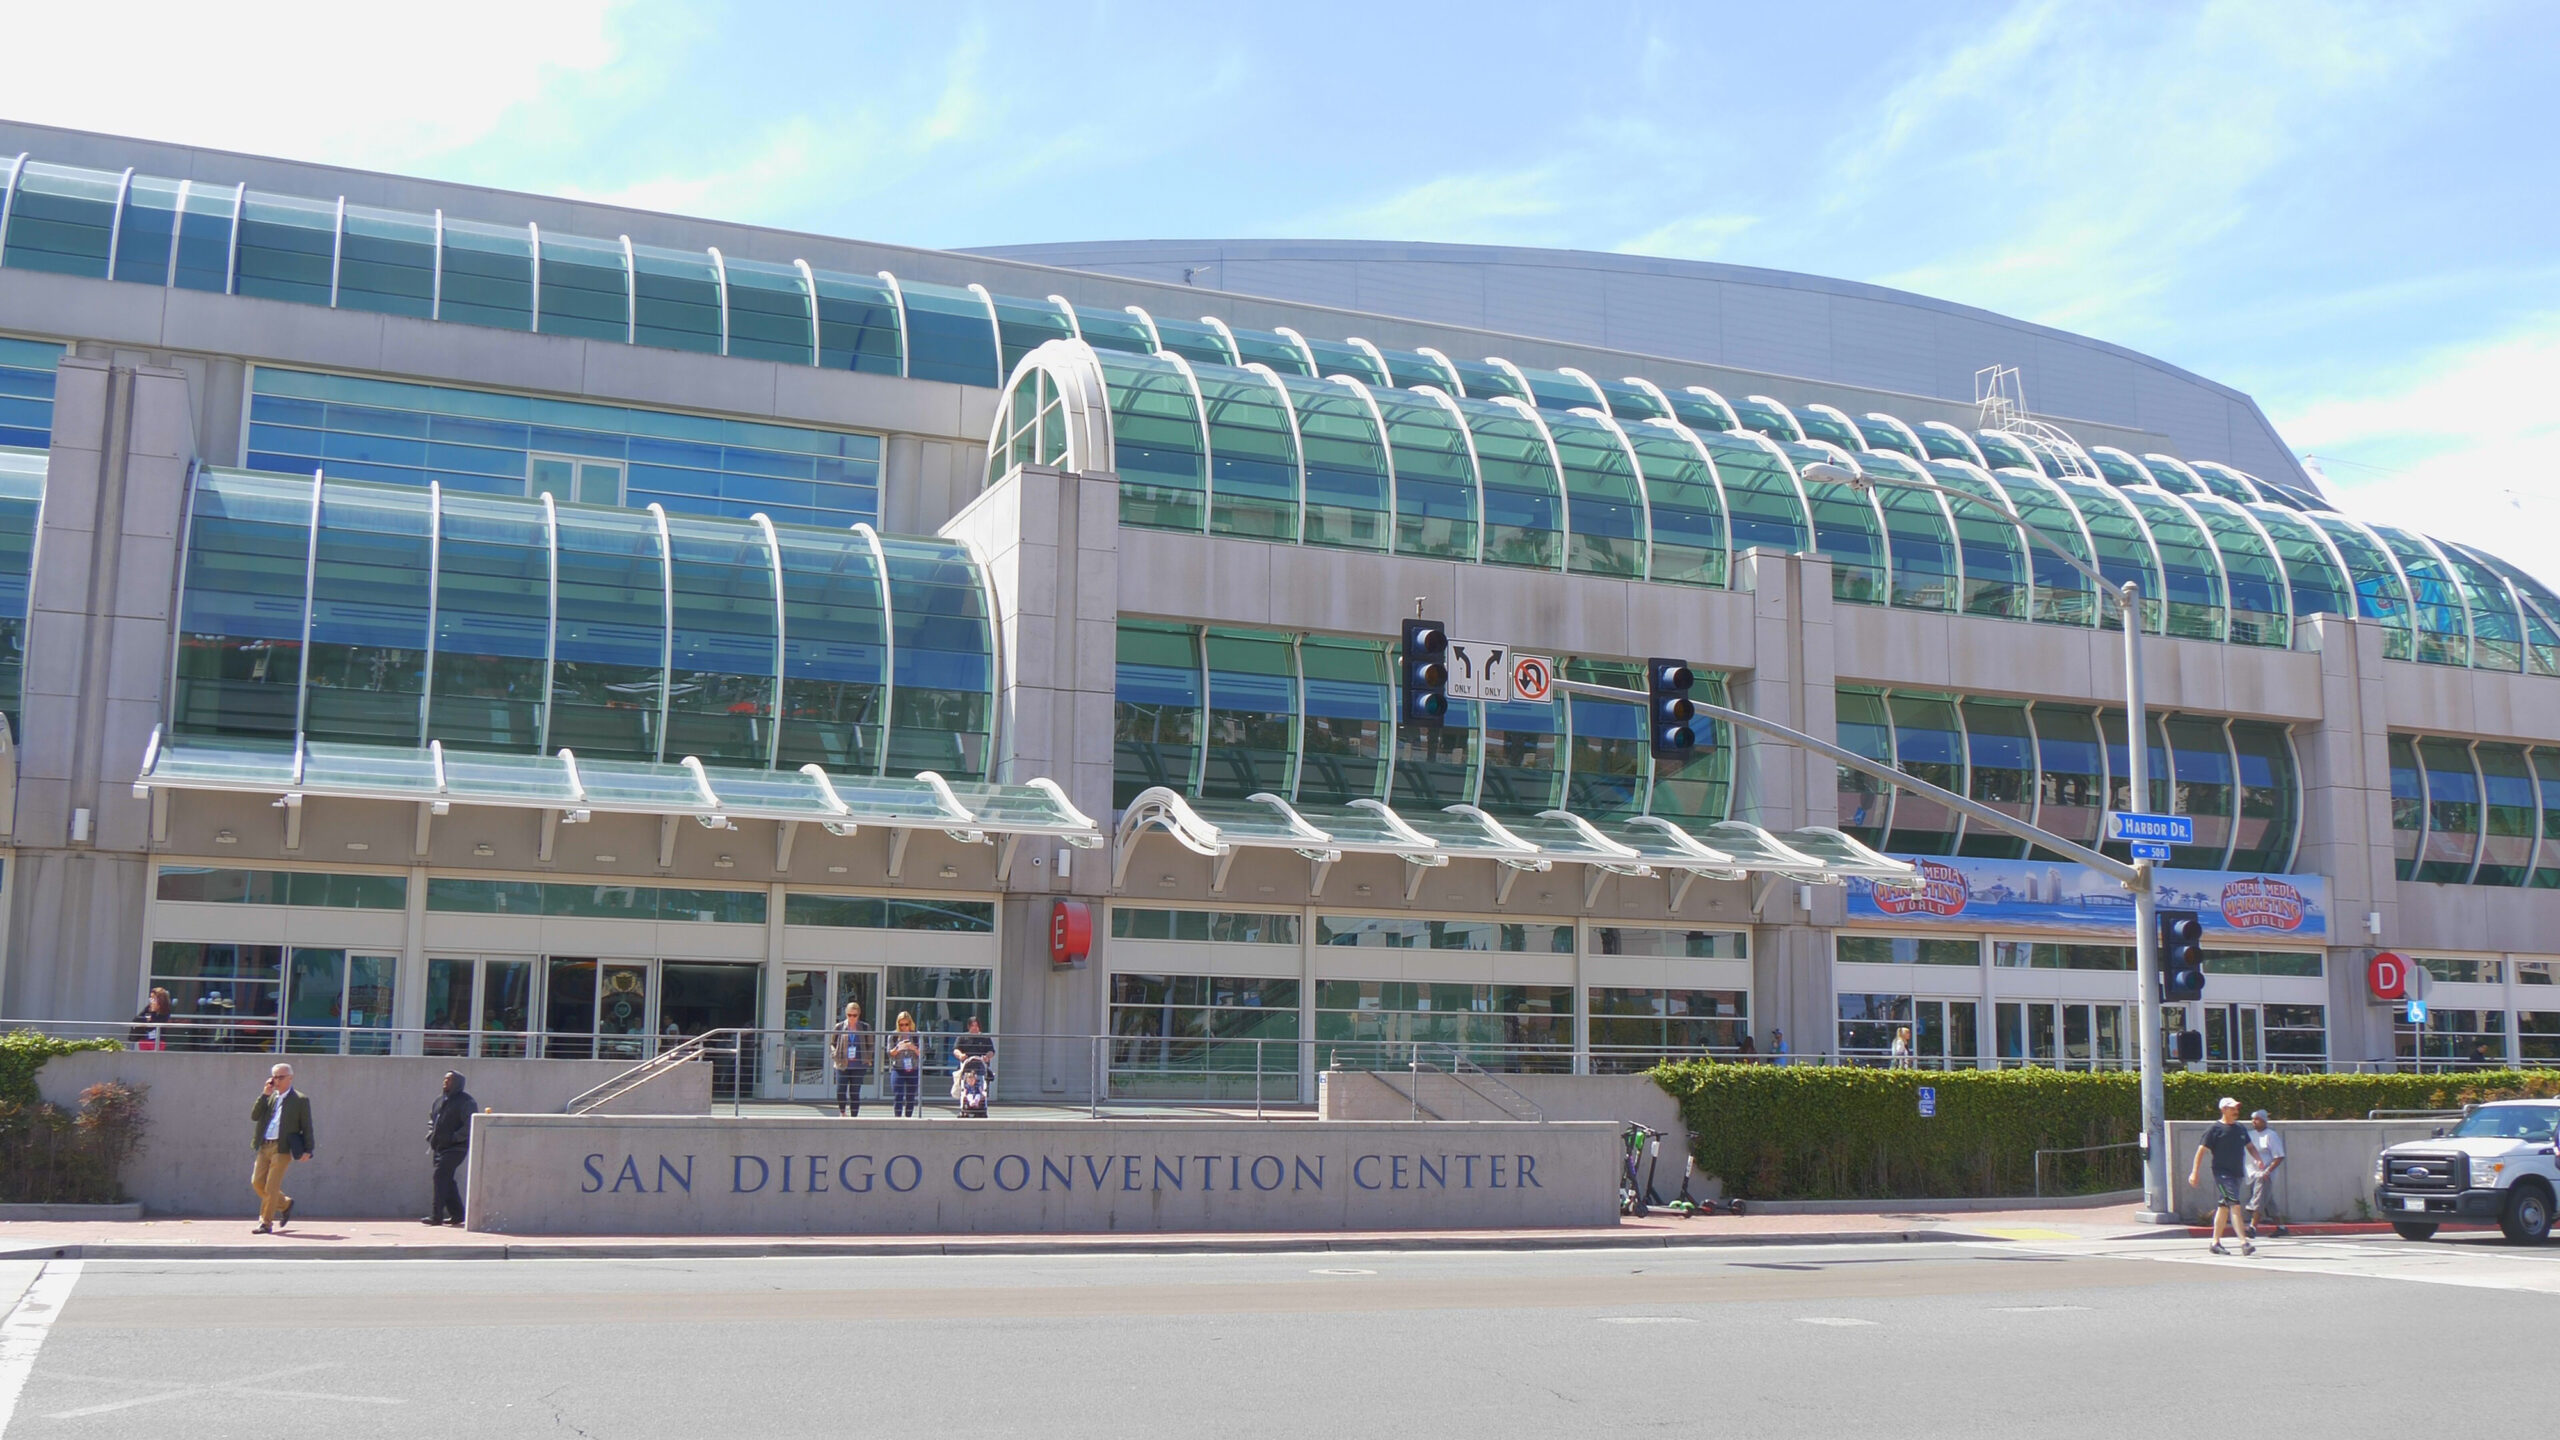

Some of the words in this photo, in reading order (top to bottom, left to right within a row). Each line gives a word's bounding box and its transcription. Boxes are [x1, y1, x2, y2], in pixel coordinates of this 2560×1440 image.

[1454, 684, 1471, 693] ONLY
[1485, 687, 1501, 696] ONLY
[2125, 818, 2167, 836] HARBOR
[2170, 822, 2188, 837] DR.
[2151, 847, 2165, 857] 500
[1923, 866, 1962, 885] MEDIA
[2224, 882, 2261, 896] SOCIAL
[2265, 883, 2298, 899] MEDIA
[1895, 900, 1945, 914] WORLD
[2224, 896, 2300, 918] MARKETING
[2241, 915, 2285, 928] WORLD
[1055, 915, 1064, 949] E
[2378, 963, 2397, 989] D
[581, 1154, 695, 1193] SAN
[729, 1154, 923, 1193] DIEGO
[952, 1154, 1325, 1193] CONVENTION
[1352, 1154, 1543, 1191] CENTER
